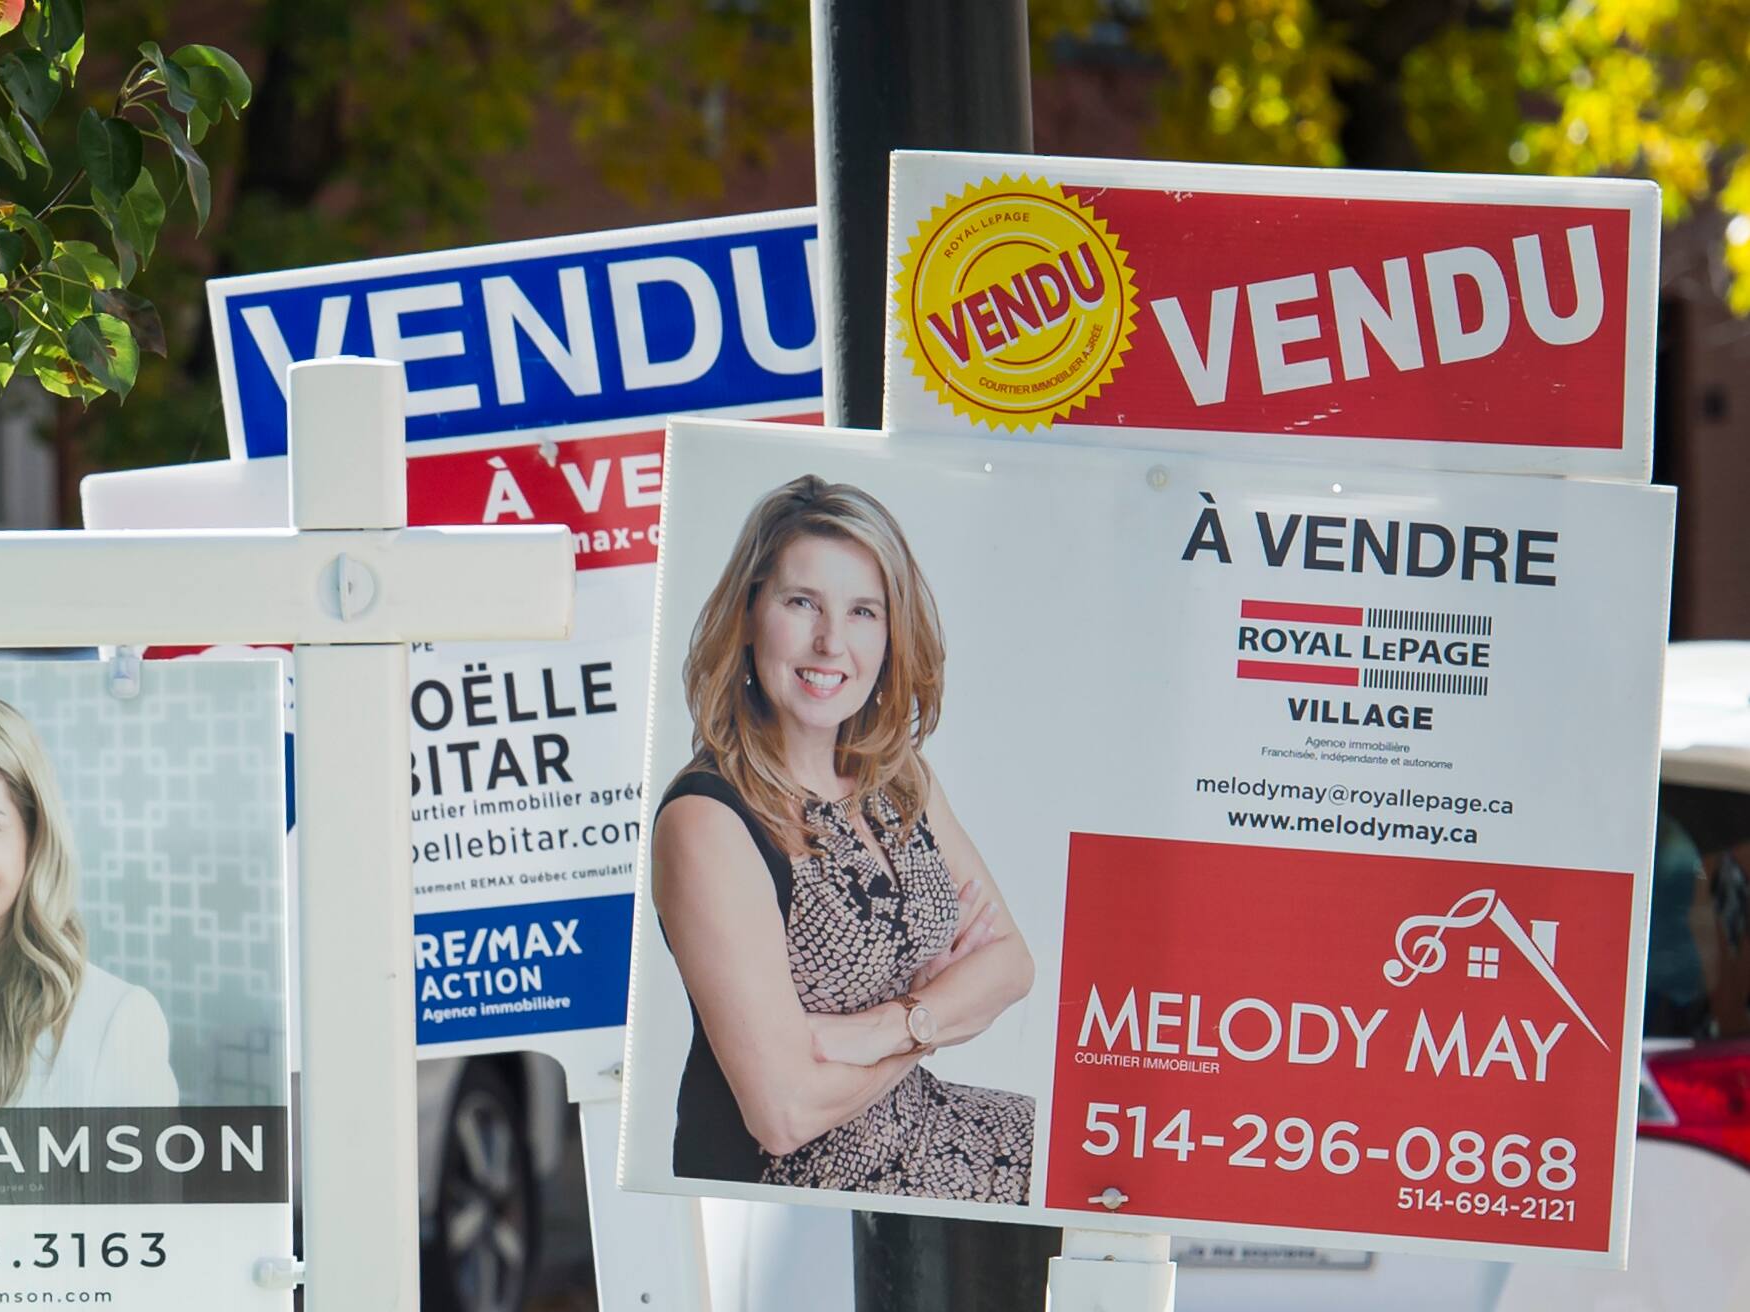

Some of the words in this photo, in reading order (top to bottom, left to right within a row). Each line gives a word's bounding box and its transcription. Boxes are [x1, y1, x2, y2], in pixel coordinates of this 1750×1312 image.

[944, 224, 979, 258] ROYAL
[926, 241, 1105, 366] VENDU
[1150, 224, 1605, 407] VENDU
[241, 239, 823, 416] VENDU
[979, 376, 1030, 394] COURTIER
[1031, 358, 1085, 393] IMMOBILIER
[482, 456, 535, 523] À
[1181, 491, 1232, 564] À
[1255, 511, 1559, 587] VENDRE
[1238, 626, 1351, 658] ROYAL
[411, 662, 617, 731] OËLLE
[1288, 697, 1434, 730] VILLAGE
[1305, 736, 1346, 750] Agence
[1349, 739, 1410, 753] immobilière
[1321, 750, 1388, 766] indépendante
[1390, 757, 1401, 766] et
[1402, 758, 1453, 770] autonome
[412, 803, 465, 821] urtier
[473, 791, 581, 815] immobilier
[1196, 777, 1513, 814] melodymay@royallepage.ca
[1228, 810, 1478, 844] www.melodymay.ca
[415, 881, 465, 894] ssement
[471, 876, 514, 888] REMAX
[520, 871, 567, 884] Québec
[572, 863, 633, 879] cumulatif
[414, 919, 582, 970] RE/MAX
[421, 965, 542, 1002] ACTION
[422, 1004, 477, 1023] Agence
[480, 996, 571, 1015] immobilière
[1077, 984, 1388, 1069] MELODY
[1405, 1009, 1569, 1082] MAY
[1075, 1052, 1139, 1069] COURTIER
[1143, 1057, 1220, 1074] IMMOBILIER
[1082, 1103, 1577, 1191] 514-296-0868
[1397, 1188, 1576, 1222] 514-694-2121
